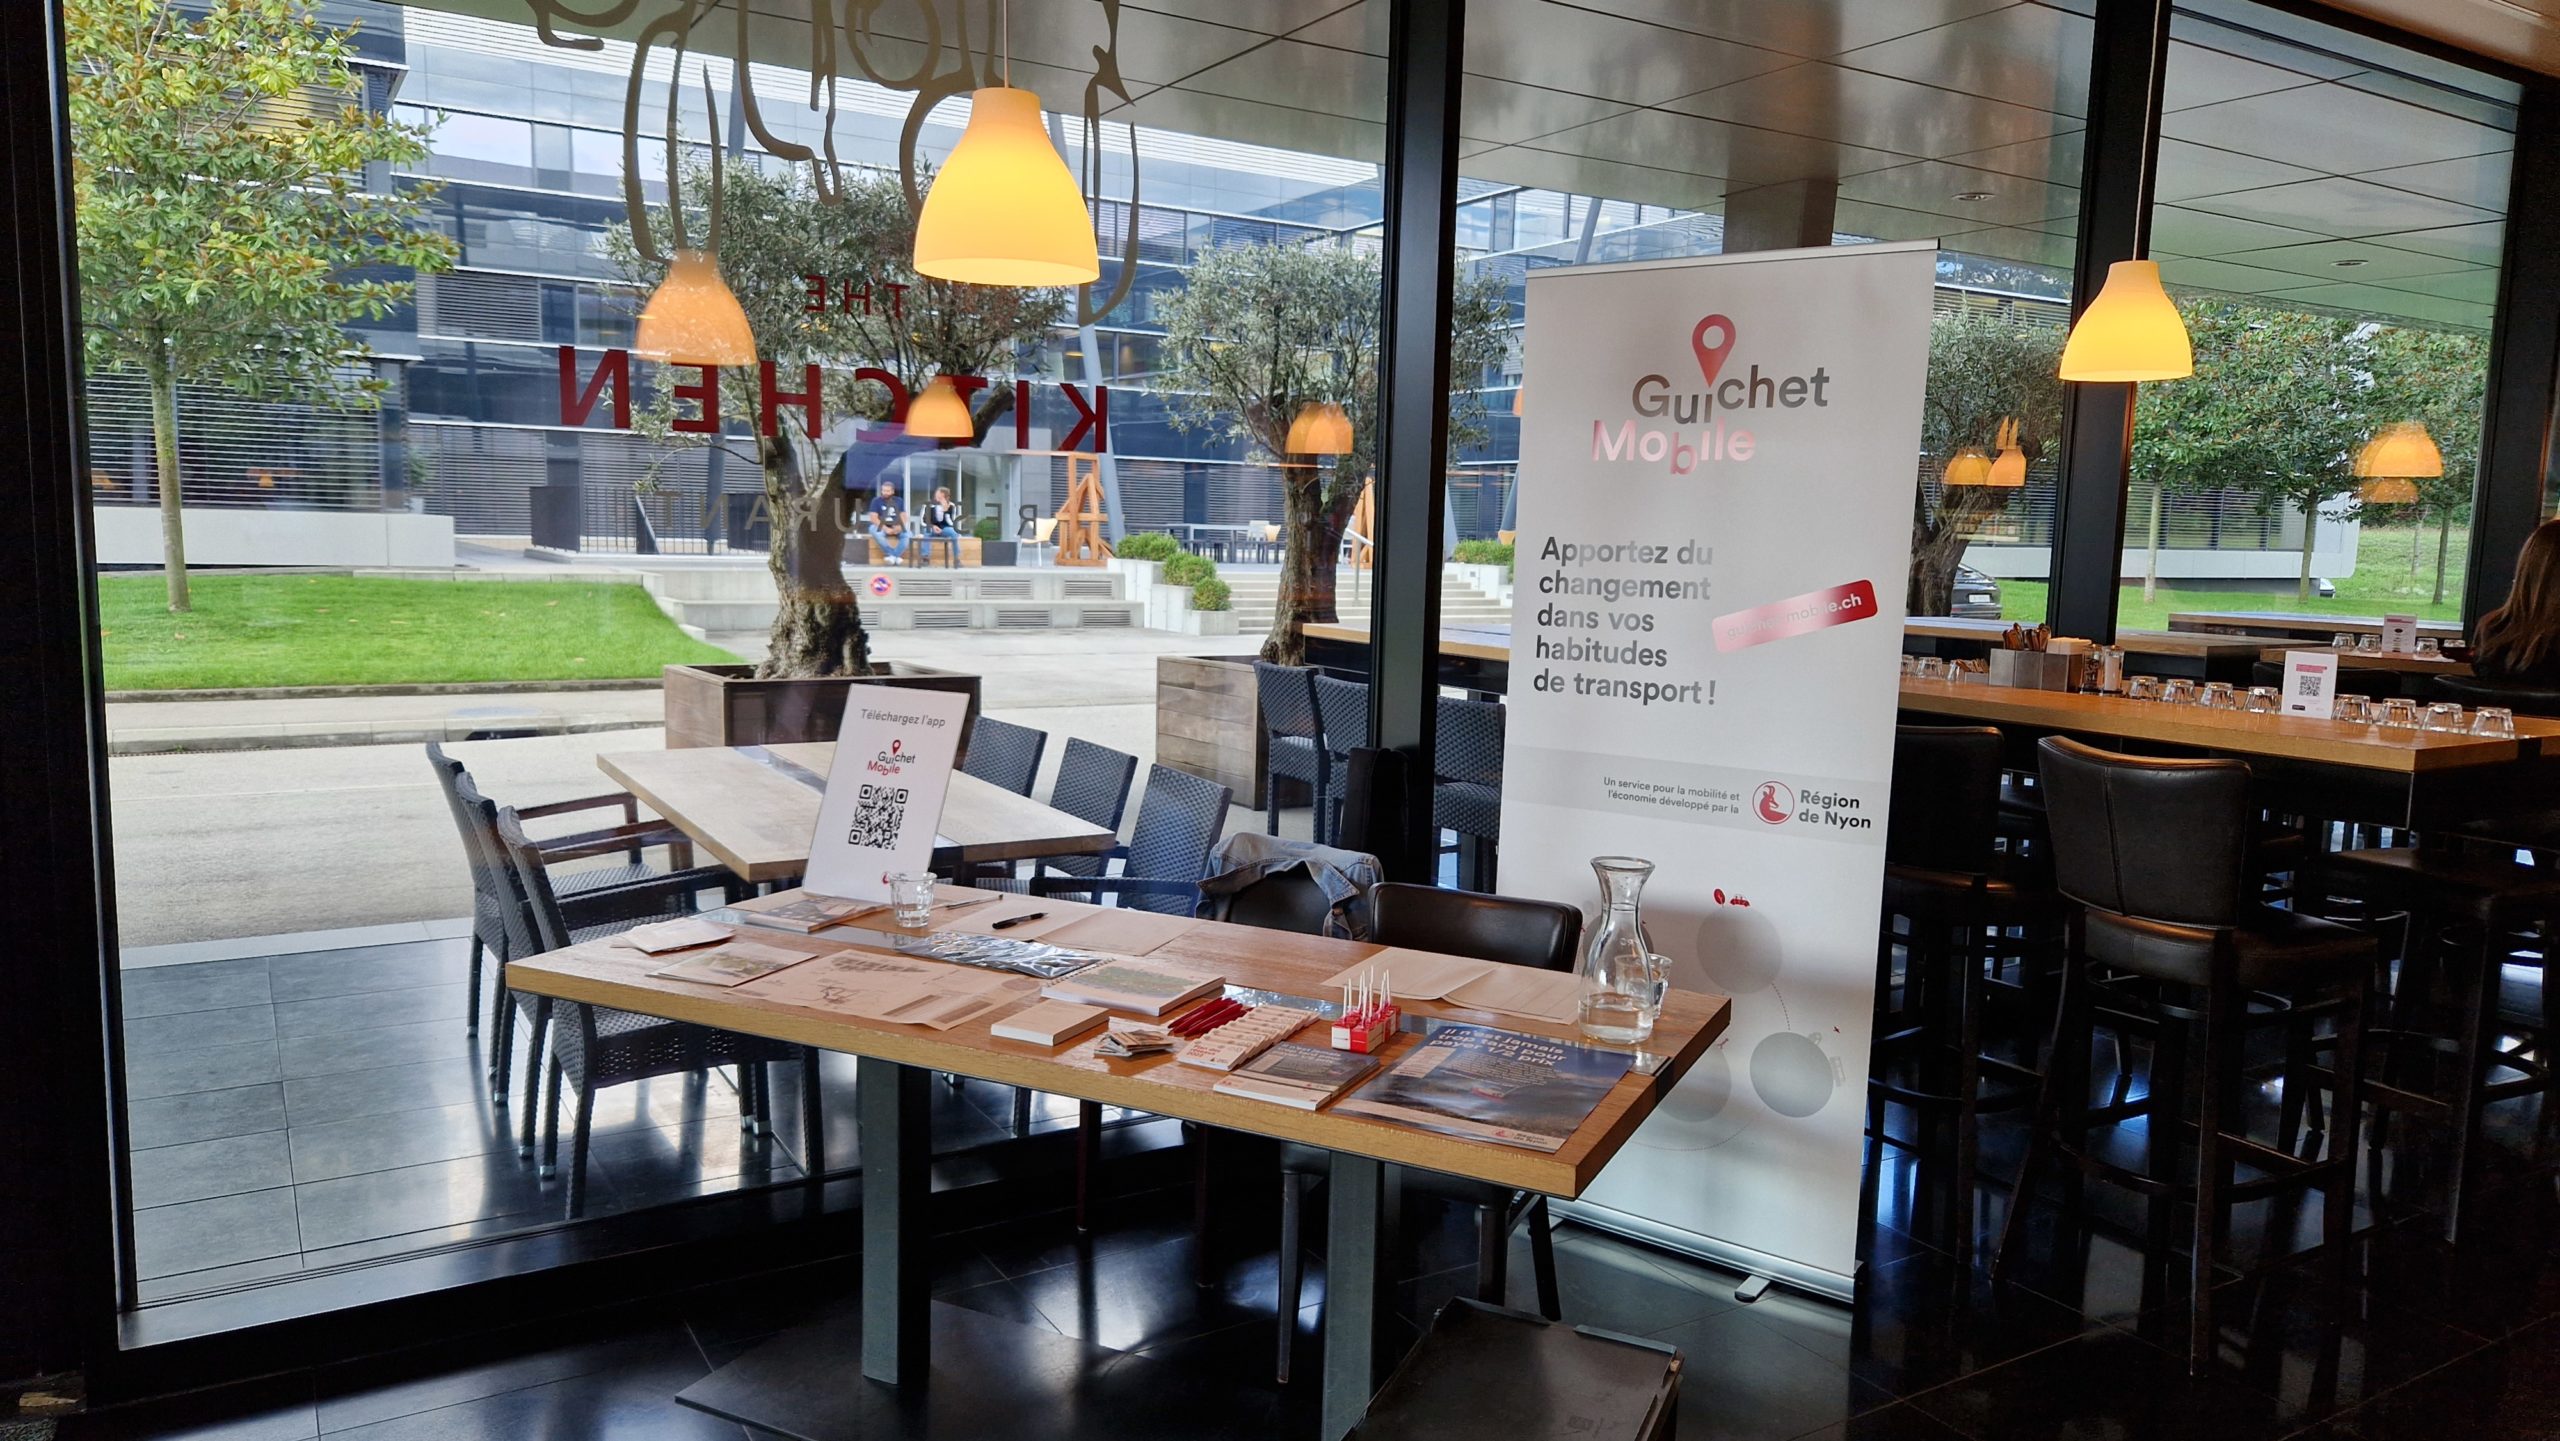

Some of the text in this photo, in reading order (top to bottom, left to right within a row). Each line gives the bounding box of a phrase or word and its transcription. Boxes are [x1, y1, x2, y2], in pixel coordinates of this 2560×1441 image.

[1632, 365, 1830, 424] Guichet
[1592, 416, 1756, 475] Mobile
[1540, 536, 1713, 567] Apportez du
[1539, 569, 1712, 602] changement
[1537, 602, 1655, 632] dans vos
[1535, 634, 1668, 667] habitudes
[1533, 668, 1565, 693] de
[861, 708, 920, 726] Téléchargez
[867, 760, 901, 776] Mobile
[877, 751, 916, 764] Guichet
[1603, 777, 1740, 801] Un service pour la mobilité et
[1800, 789, 1860, 809] Région
[1659, 796, 1709, 811] développé
[1711, 804, 1728, 814] par
[1730, 804, 1739, 814] la
[1798, 808, 1871, 829] de Nyon
[1502, 1037, 1564, 1055] jamais
[1520, 1048, 1567, 1061] pour
[1517, 1055, 1556, 1067] prix
